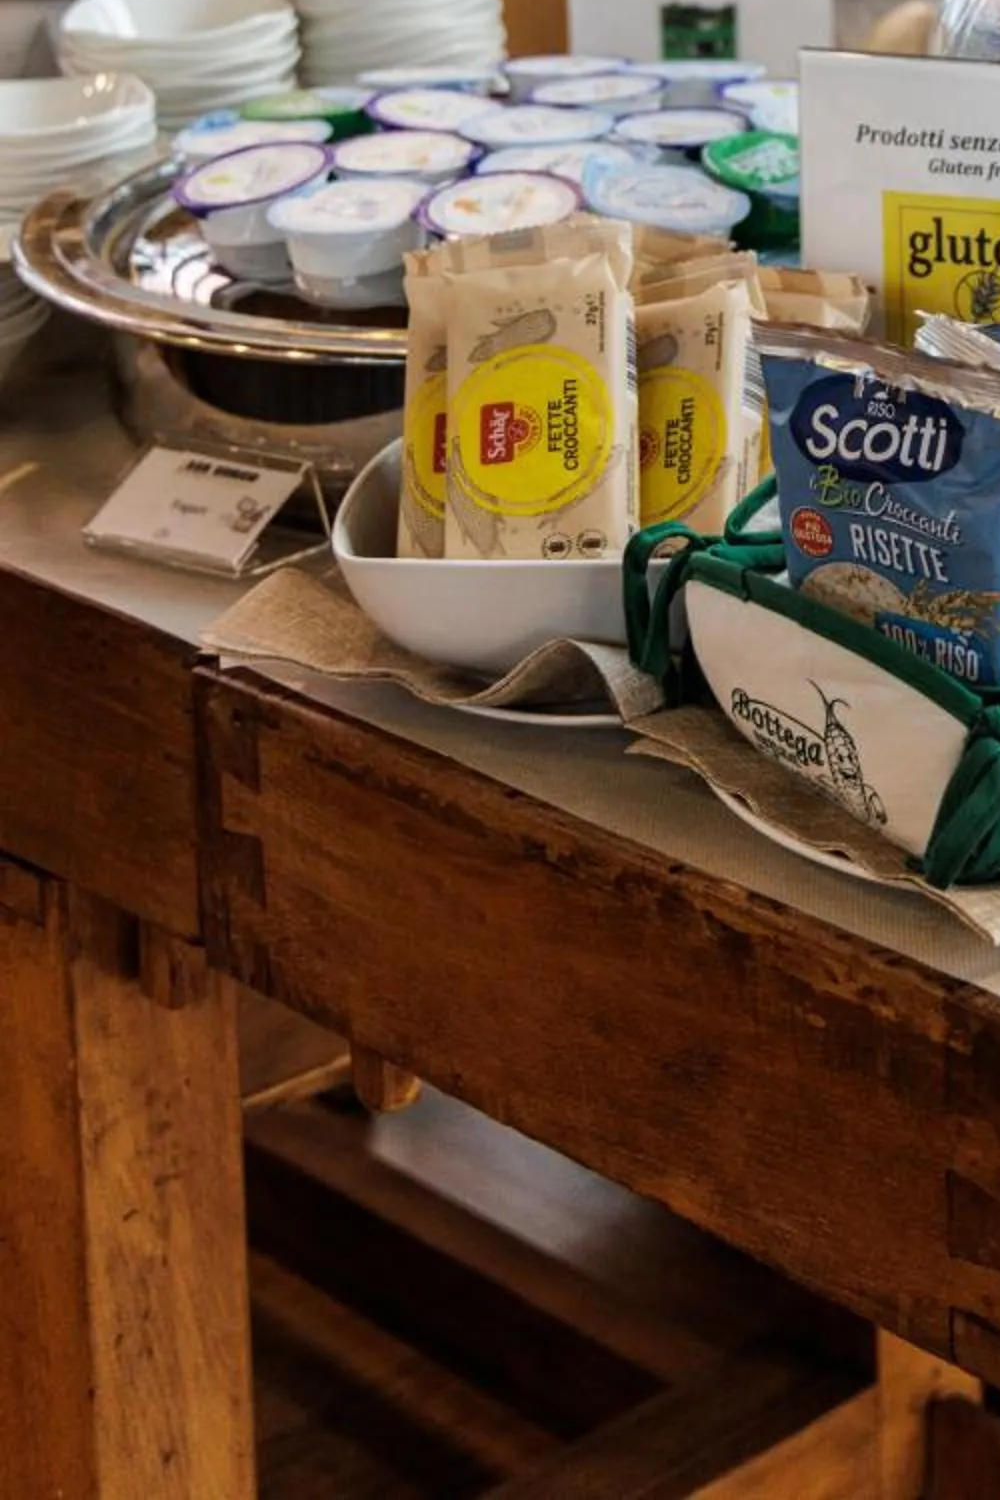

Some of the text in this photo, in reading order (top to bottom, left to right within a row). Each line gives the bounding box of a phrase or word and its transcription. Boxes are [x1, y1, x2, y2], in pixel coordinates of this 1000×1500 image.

[855, 123, 946, 150] Prodotti
[928, 157, 985, 177] Gluten
[547, 400, 563, 453] FETTE
[564, 379, 578, 471] CROCCANTI
[866, 400, 897, 418] RISO
[664, 418, 679, 468] FETTE
[677, 397, 695, 485] CROCCANTI
[805, 403, 948, 472] Scotti
[850, 523, 949, 583] RISETTE
[732, 688, 825, 768] Bottega
